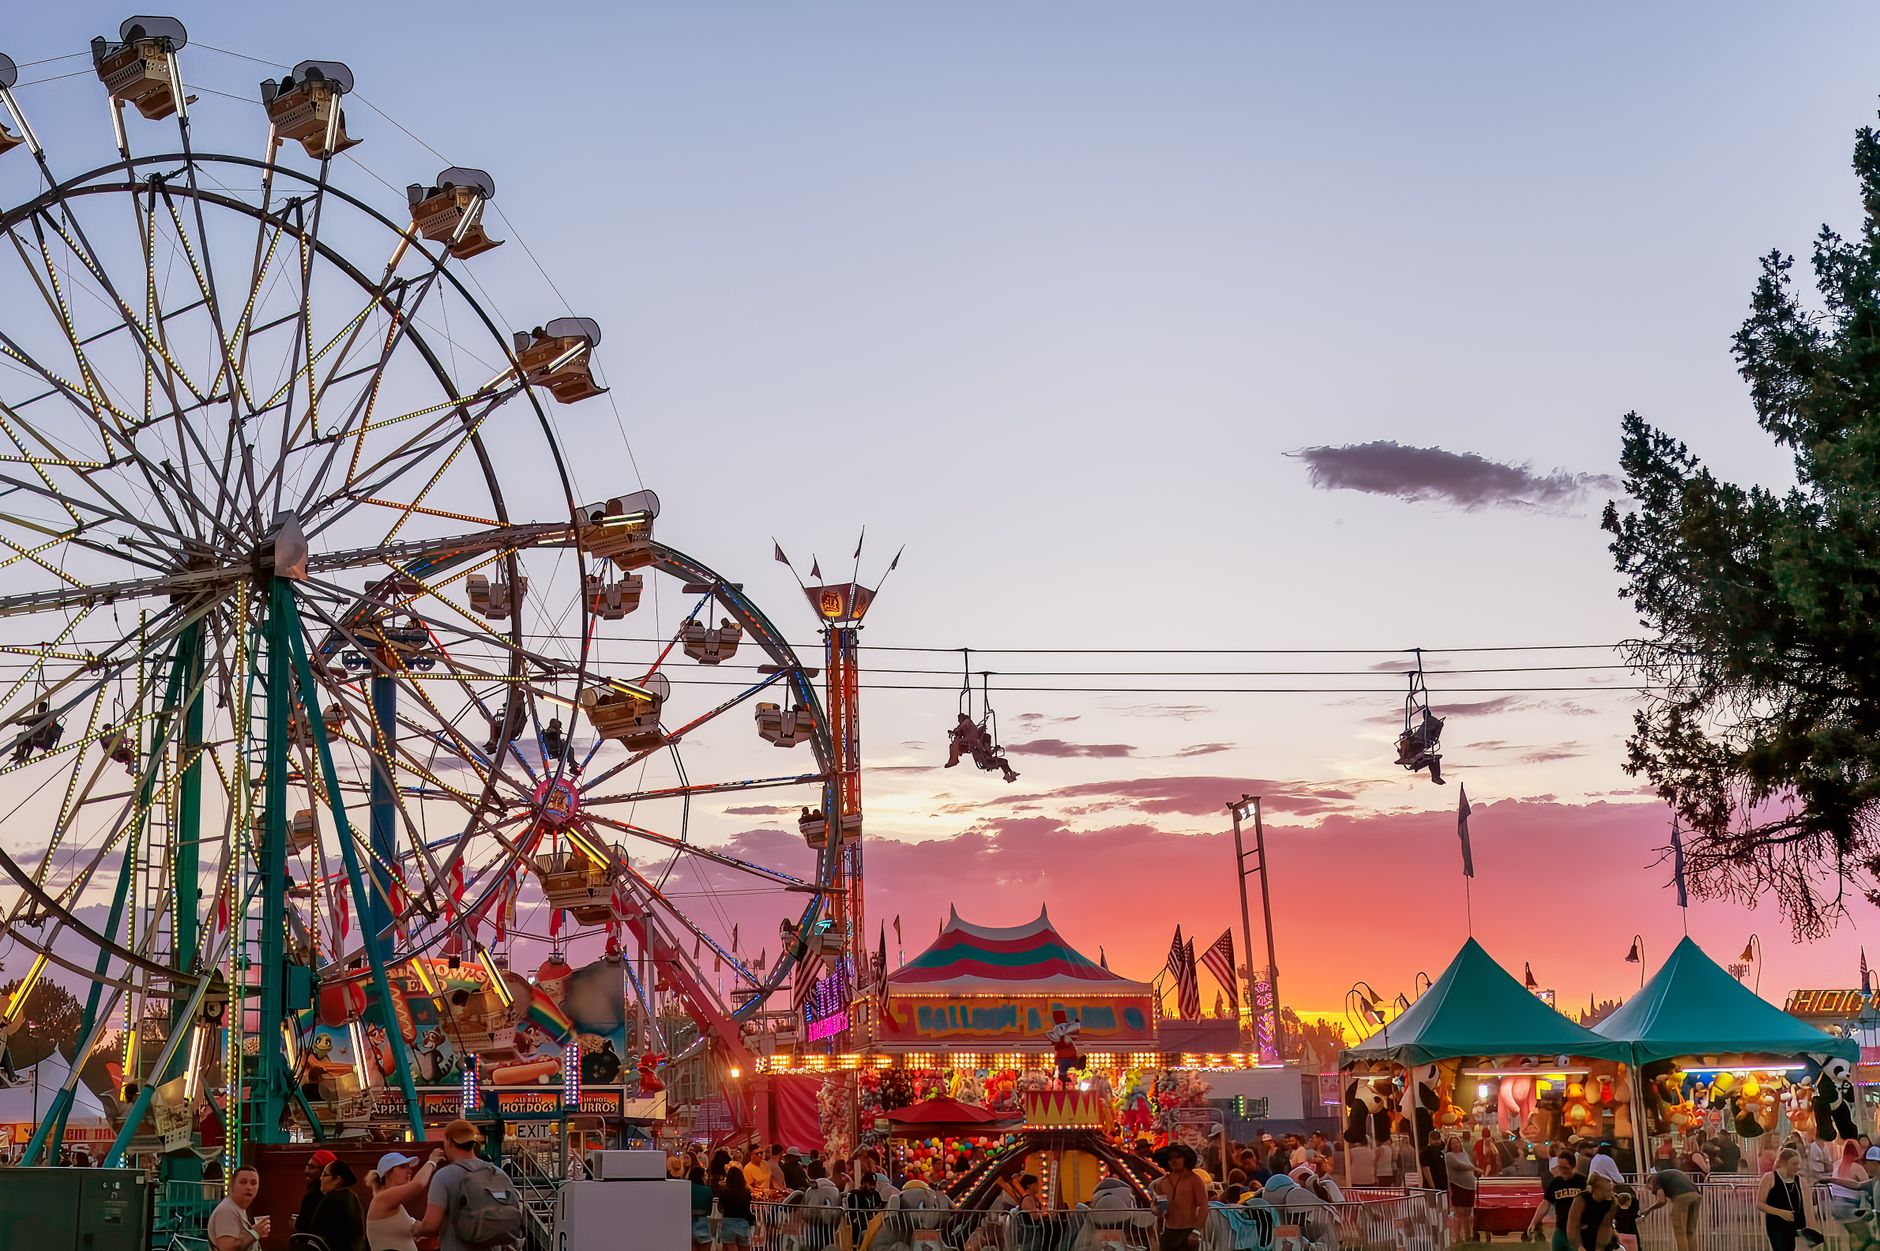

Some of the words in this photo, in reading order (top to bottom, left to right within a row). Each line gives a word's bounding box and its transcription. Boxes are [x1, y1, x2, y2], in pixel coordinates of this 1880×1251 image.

[385, 963, 487, 982] AINOW'S
[406, 980, 448, 992] ED
[430, 1104, 461, 1114] NACH
[502, 1103, 523, 1113] HOT
[526, 1103, 554, 1113] DOGS
[580, 1103, 616, 1113] URROS
[518, 1124, 549, 1138] EXIT
